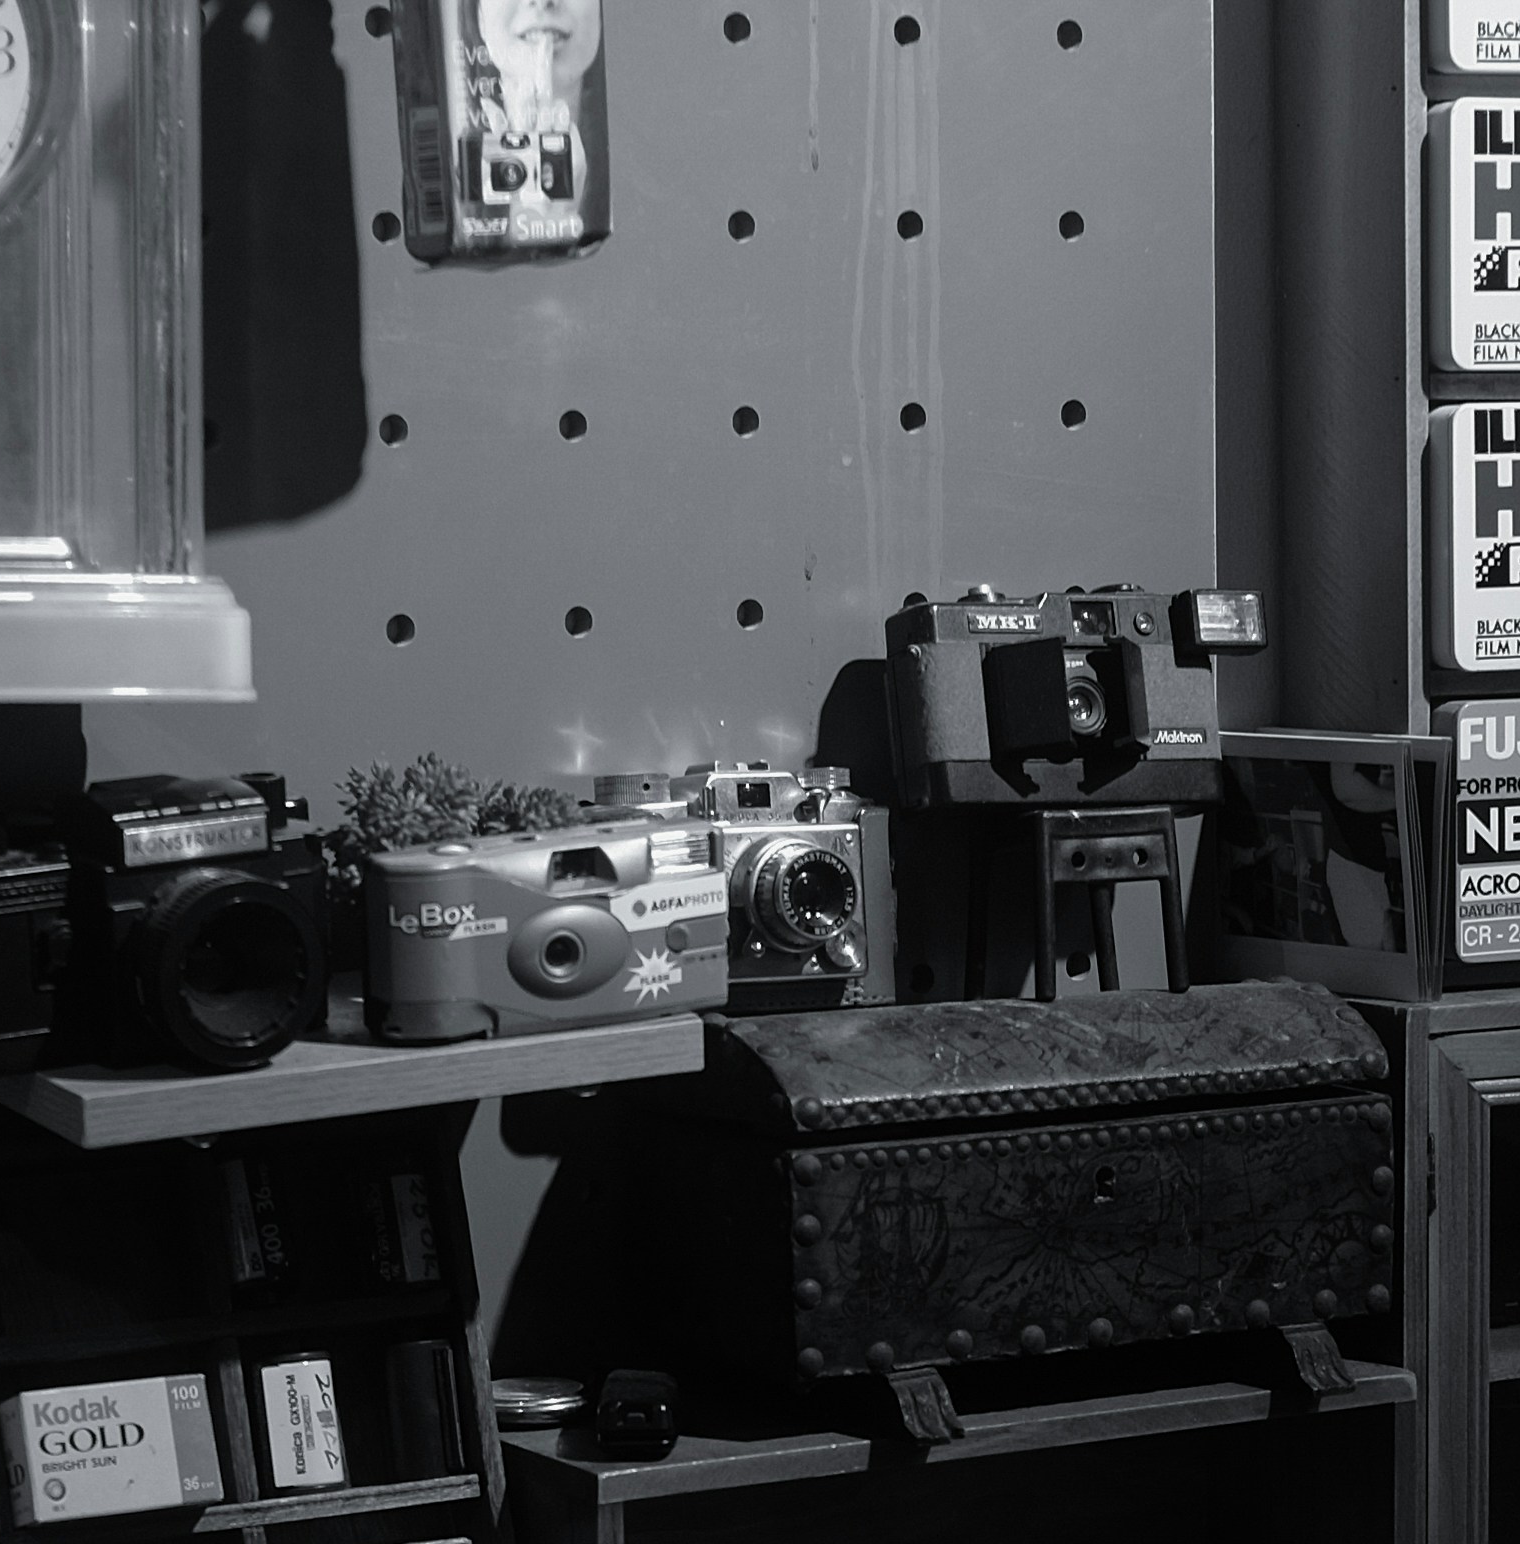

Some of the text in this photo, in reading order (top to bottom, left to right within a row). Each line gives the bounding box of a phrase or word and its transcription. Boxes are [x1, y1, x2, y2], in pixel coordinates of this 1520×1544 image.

[1476, 43, 1512, 59] FILM
[1475, 323, 1520, 339] BLACK
[1474, 344, 1508, 361] FILM
[1476, 639, 1511, 656] FILM
[1457, 778, 1492, 796] FOR
[130, 826, 262, 857] KONSTRUKTOR
[650, 890, 724, 913] AGFAPHOTO
[1464, 926, 1492, 946] CR
[253, 1186, 285, 1266] 400 36
[170, 1385, 199, 1401] 100
[33, 1395, 121, 1428] Kodak
[174, 1401, 202, 1411] FILM
[39, 1421, 146, 1457] GOLD
[289, 1431, 307, 1475] Konica
[41, 1455, 118, 1474] BRIGHT SUN
[183, 1476, 201, 1491] 36
